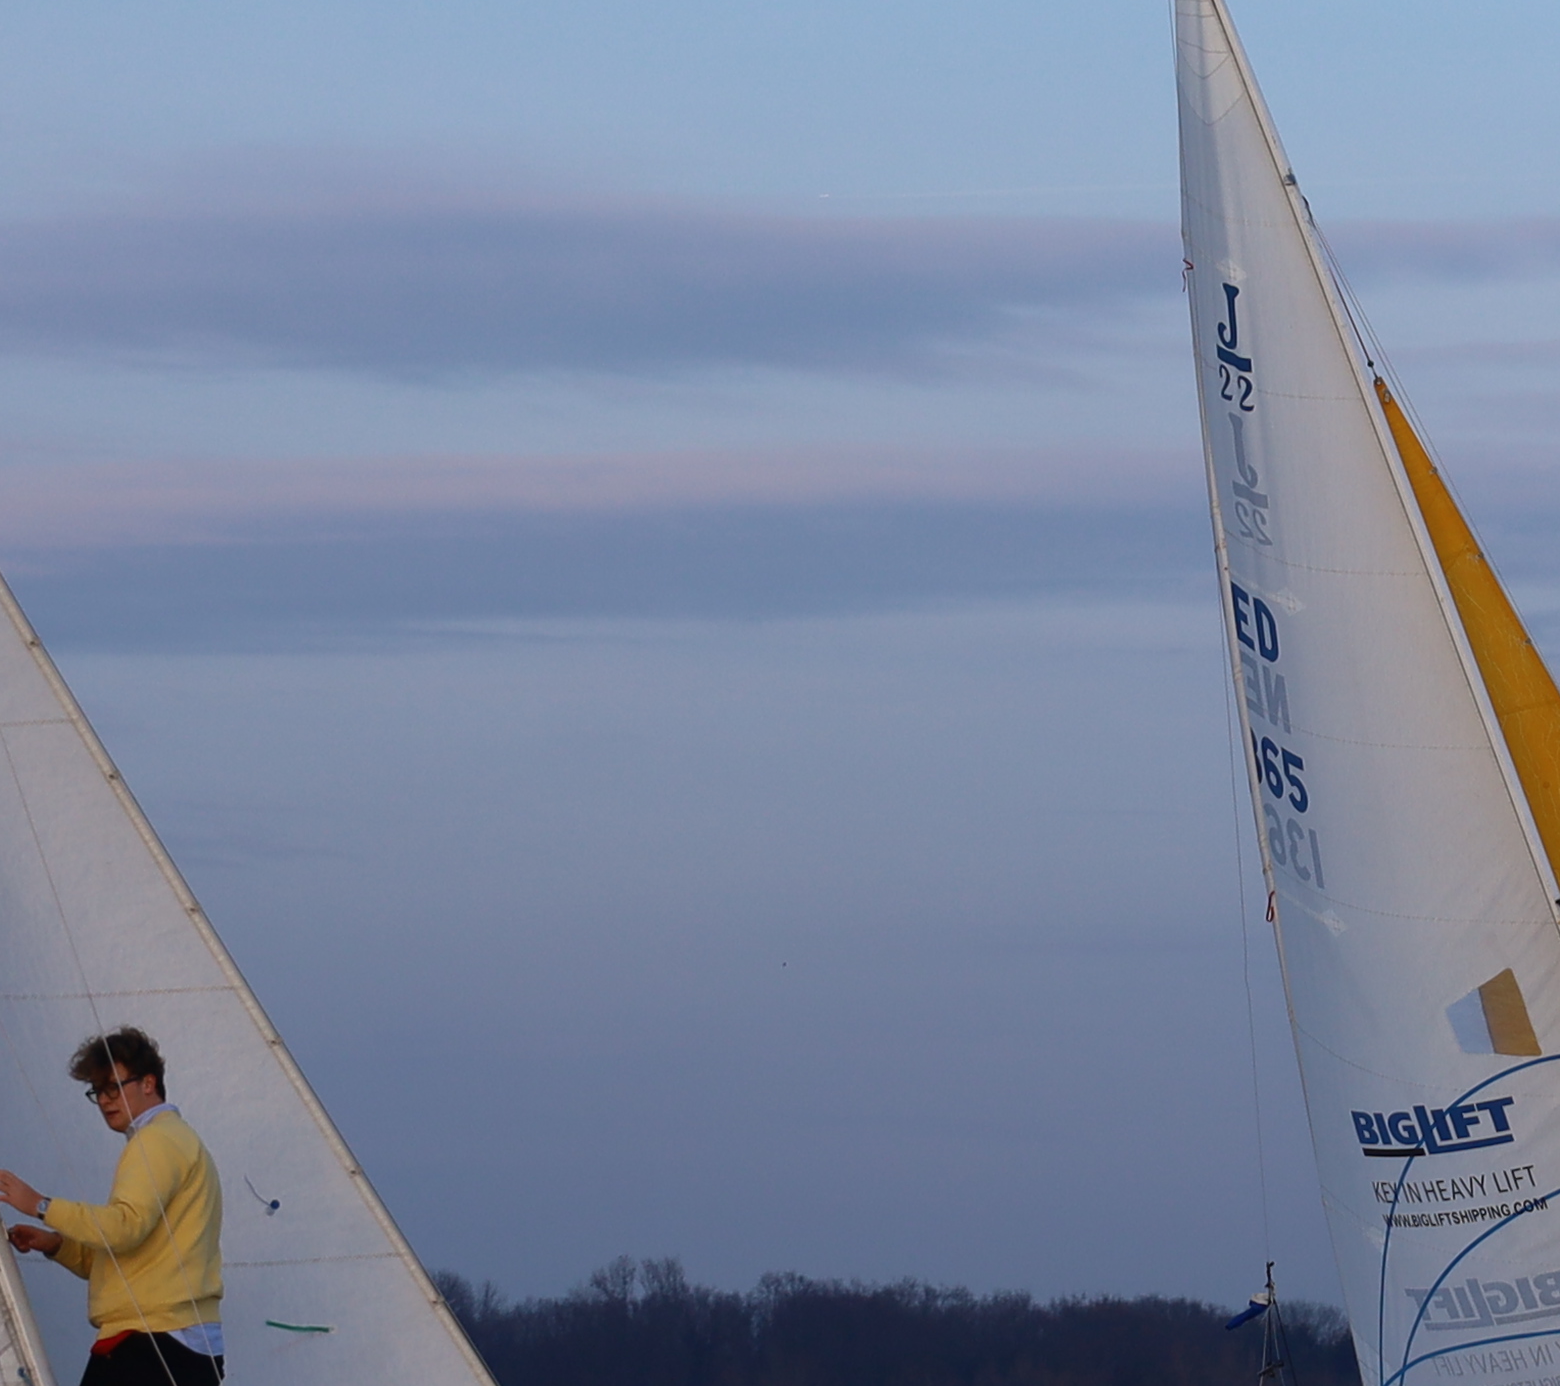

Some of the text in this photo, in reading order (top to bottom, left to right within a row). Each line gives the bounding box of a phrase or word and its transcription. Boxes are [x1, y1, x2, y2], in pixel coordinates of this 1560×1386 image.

[1219, 364, 1255, 411] 22
[1231, 581, 1279, 663] ED
[1351, 1096, 1515, 1156] BIGLIFT
[1371, 1165, 1536, 1204] KEY IN HEAVY LIFT
[1382, 1197, 1549, 1228] WWW.BIGLIFTSHIPPING.COM
